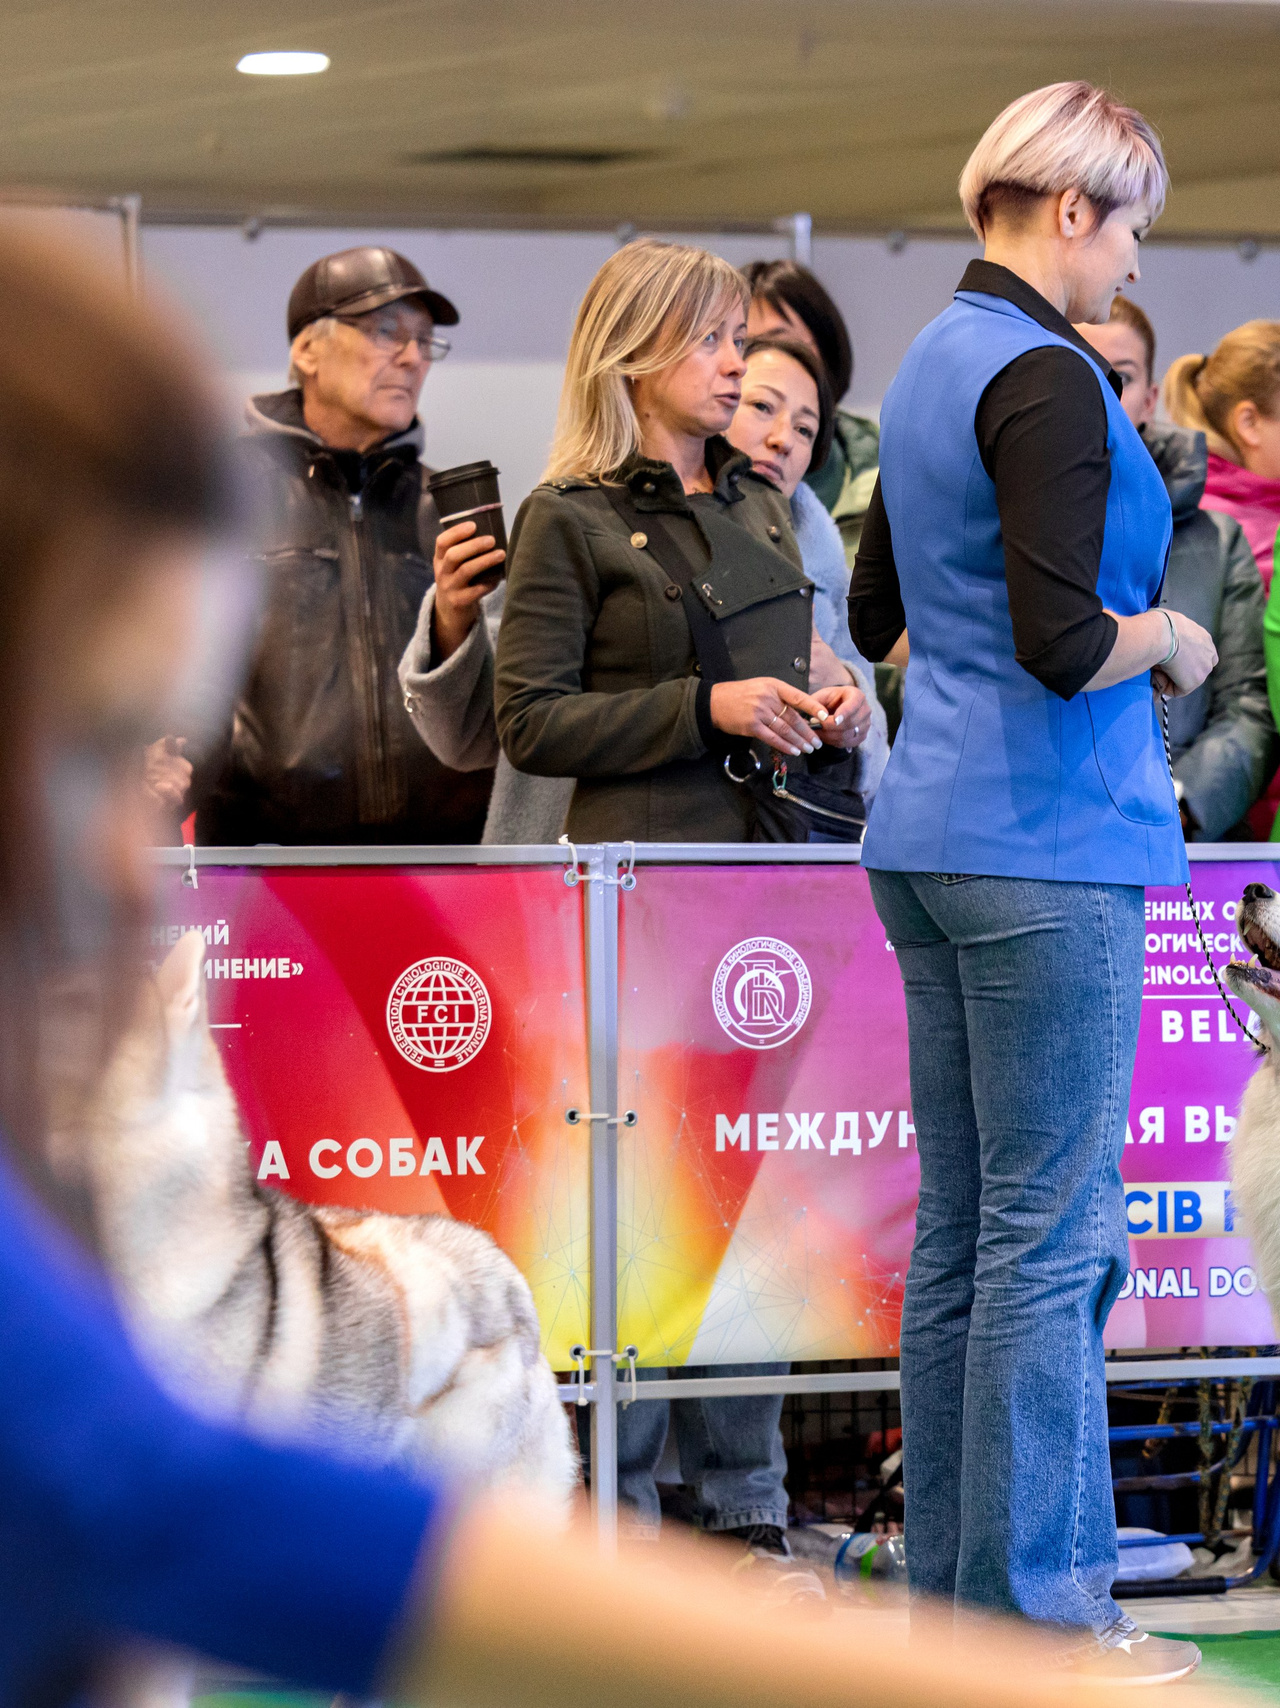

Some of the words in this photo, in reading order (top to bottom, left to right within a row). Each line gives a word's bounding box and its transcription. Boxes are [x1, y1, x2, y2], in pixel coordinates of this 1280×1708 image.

[396, 961, 466, 996] CYNOLOGIQUE
[391, 998, 424, 1063] FEDERATION
[417, 1005, 460, 1023] FCI
[455, 973, 488, 1063] INTERNATIONALE
[309, 1136, 486, 1179] СОБАК
